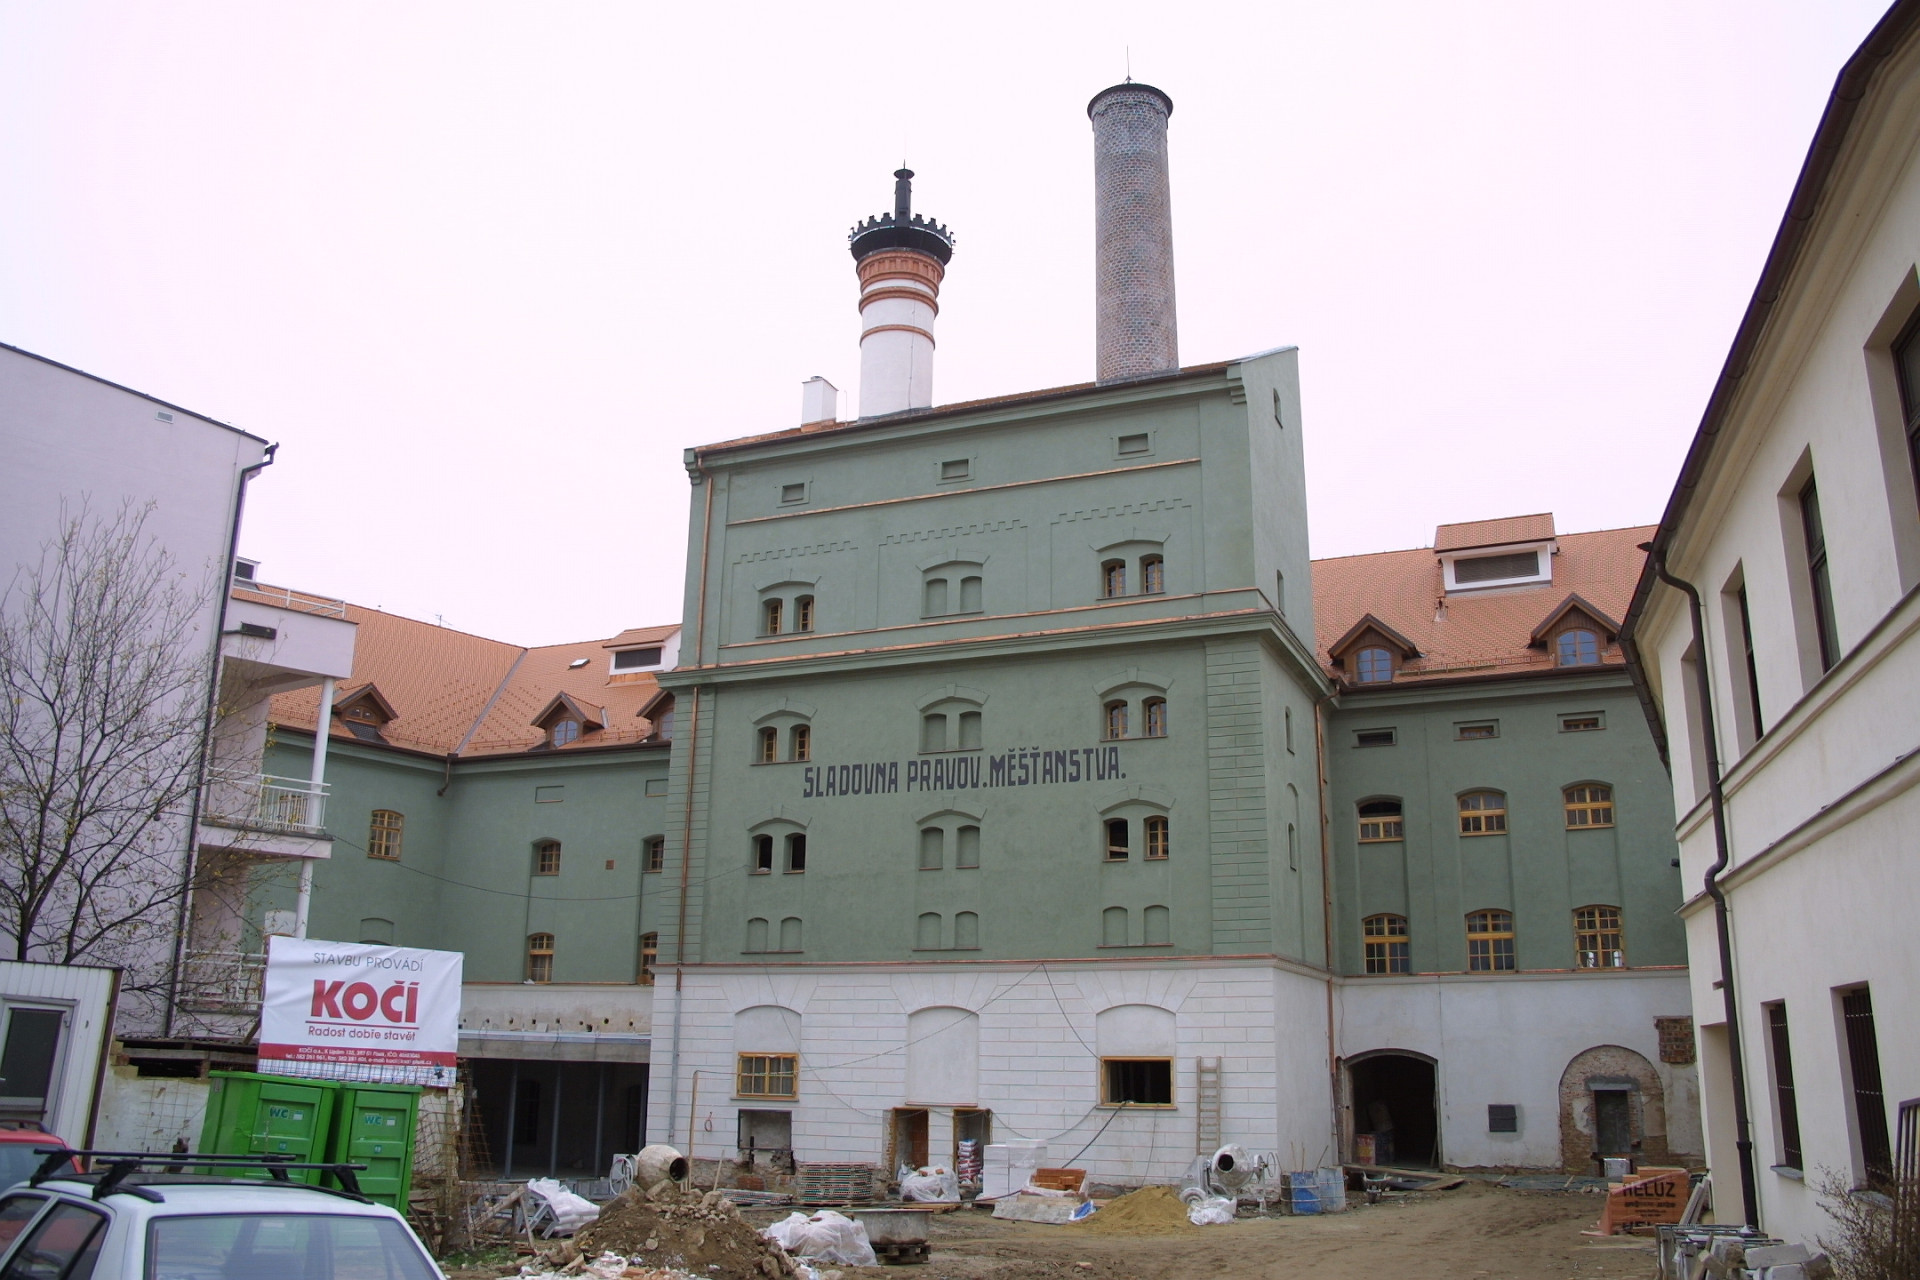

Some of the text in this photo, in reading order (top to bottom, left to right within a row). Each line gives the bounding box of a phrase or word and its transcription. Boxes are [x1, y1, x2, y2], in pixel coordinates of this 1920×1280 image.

[803, 762, 898, 798] SLADOVNA
[313, 953, 424, 972] STAVBU PROVÁDÍ
[311, 979, 420, 1023] KOČÍ
[308, 1025, 416, 1041] Radost dobře stavět
[269, 1106, 289, 1119] WC
[364, 1115, 383, 1125] WC
